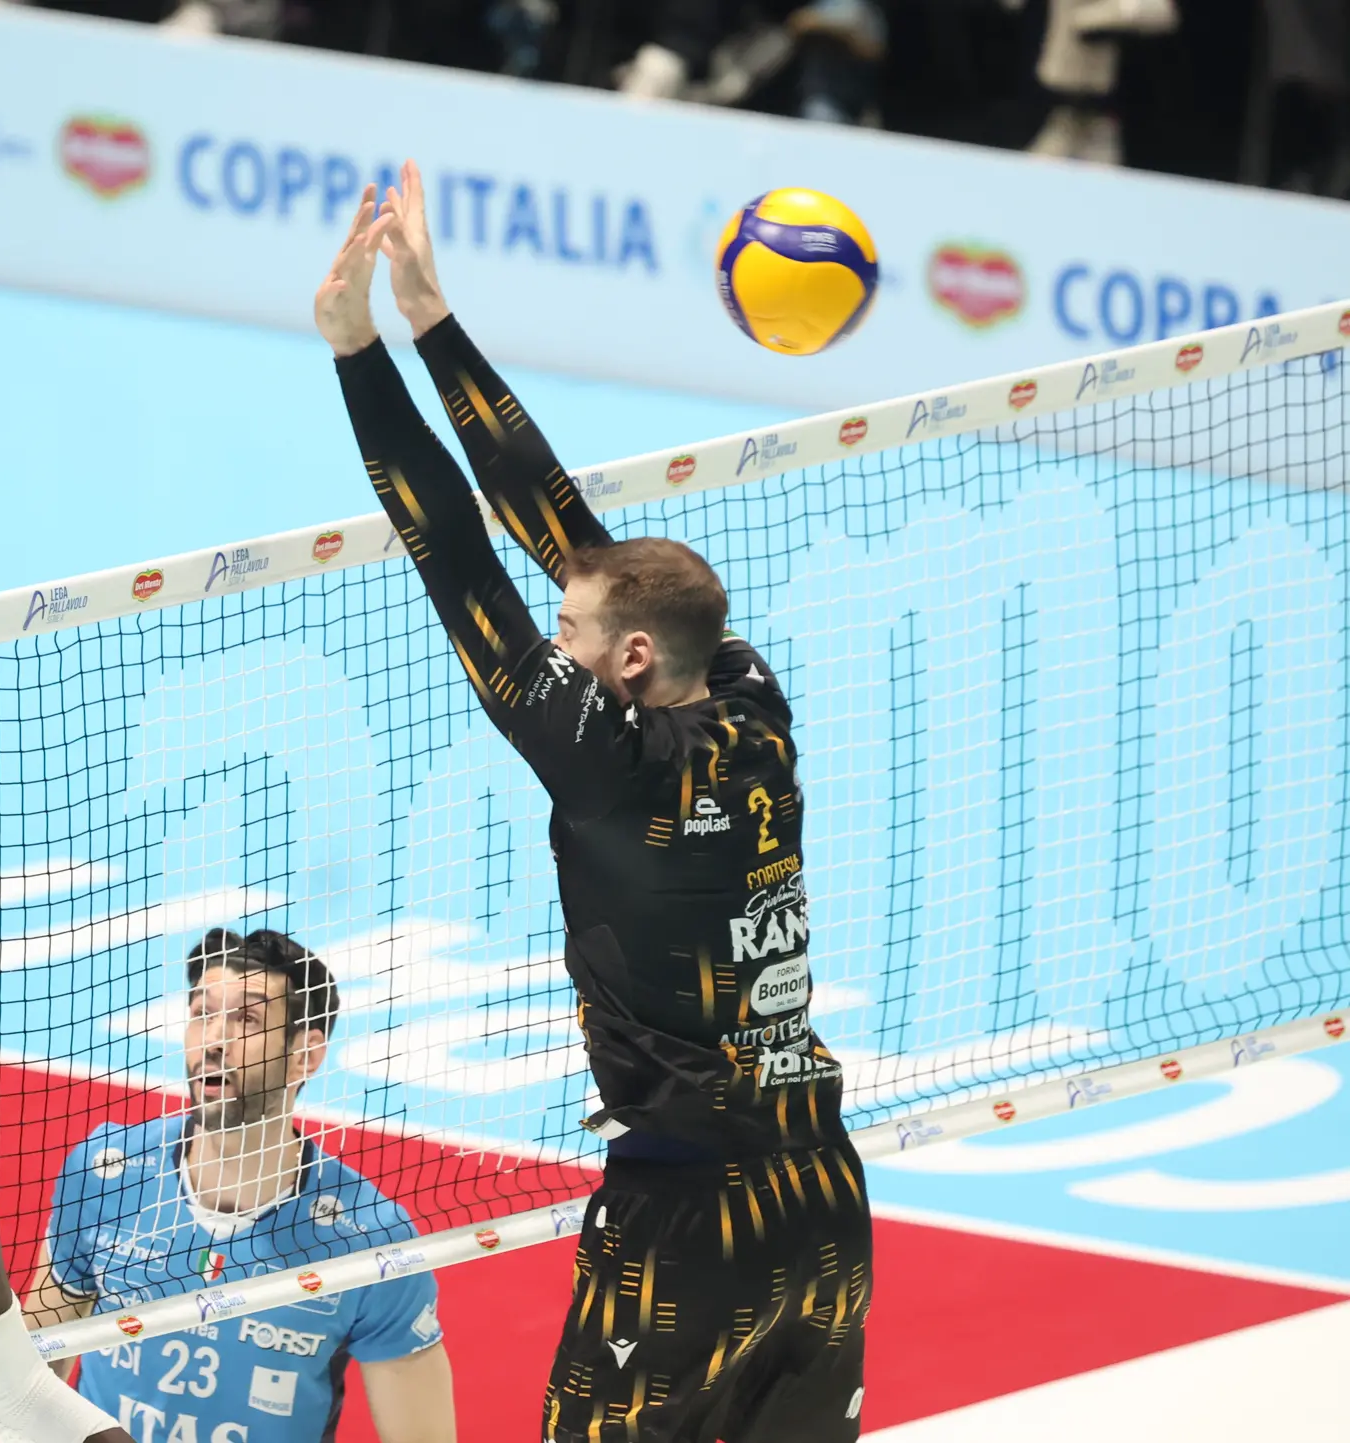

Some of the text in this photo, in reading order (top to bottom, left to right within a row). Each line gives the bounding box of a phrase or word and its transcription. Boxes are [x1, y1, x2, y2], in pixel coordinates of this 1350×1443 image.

[438, 168, 659, 275] ITALIA
[230, 556, 270, 576] PALLAVOLO
[231, 547, 250, 563] LEGA
[49, 595, 88, 614] PALLAVOLO
[50, 586, 68, 600] LEGA
[683, 814, 731, 836] poplast
[747, 786, 780, 855] 2
[729, 908, 809, 962] RAN
[758, 974, 807, 1001] Bonom
[719, 1011, 810, 1047] AUTOTEA
[238, 1317, 327, 1357] FORST
[157, 1339, 220, 1399] 23
